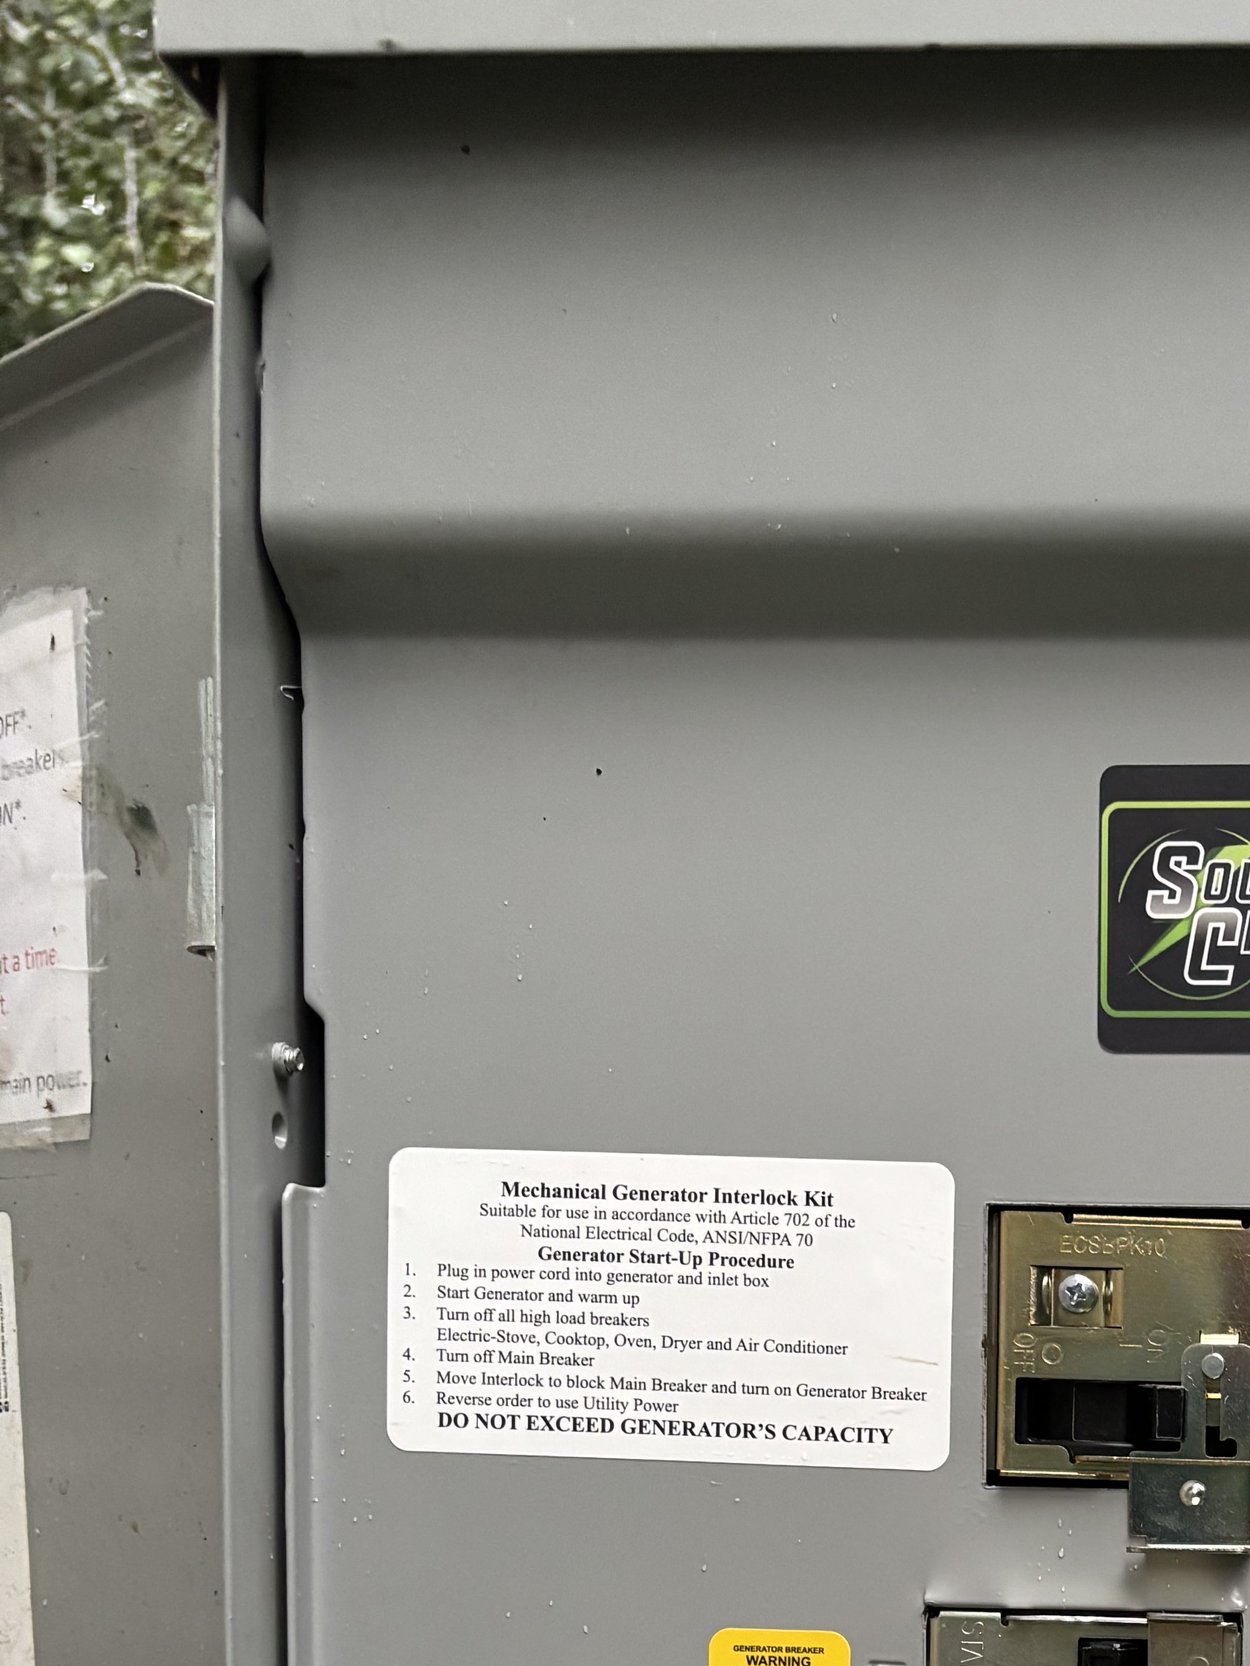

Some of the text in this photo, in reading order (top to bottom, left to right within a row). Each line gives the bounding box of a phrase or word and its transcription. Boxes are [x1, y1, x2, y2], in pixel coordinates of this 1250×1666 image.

[502, 1181, 833, 1207] Mechanical Generator Interlock Kit
[479, 1202, 855, 1228] Suitable for use in accordance with Article 702 of the
[520, 1224, 813, 1246] National Electrical Code, ANSI/NFPA 70
[538, 1246, 794, 1269] Generator Start-Up Procedure
[437, 1263, 769, 1287] Plug in power cord into generator and inlet box
[437, 1285, 639, 1308] Start Generator and warm up
[436, 1306, 649, 1327] Turn off all high load breakers
[437, 1327, 848, 1355] Electric-Stove, Cooktop, Oven, Dryer and Air Conditioner
[436, 1348, 595, 1366] Turn off Main Breaker
[436, 1370, 927, 1401] Move Interlock to block Main Breaker and turn on Generator Breaker
[436, 1391, 679, 1414] Reverse order to use Utility Power
[438, 1412, 468, 1428] DO
[475, 1413, 520, 1429] NOT
[526, 1415, 614, 1433] EXCEED
[782, 1424, 893, 1443] CAPACITY
[733, 1644, 824, 1654] GENERATOR BREAKER
[746, 1655, 811, 1666] WARNING
